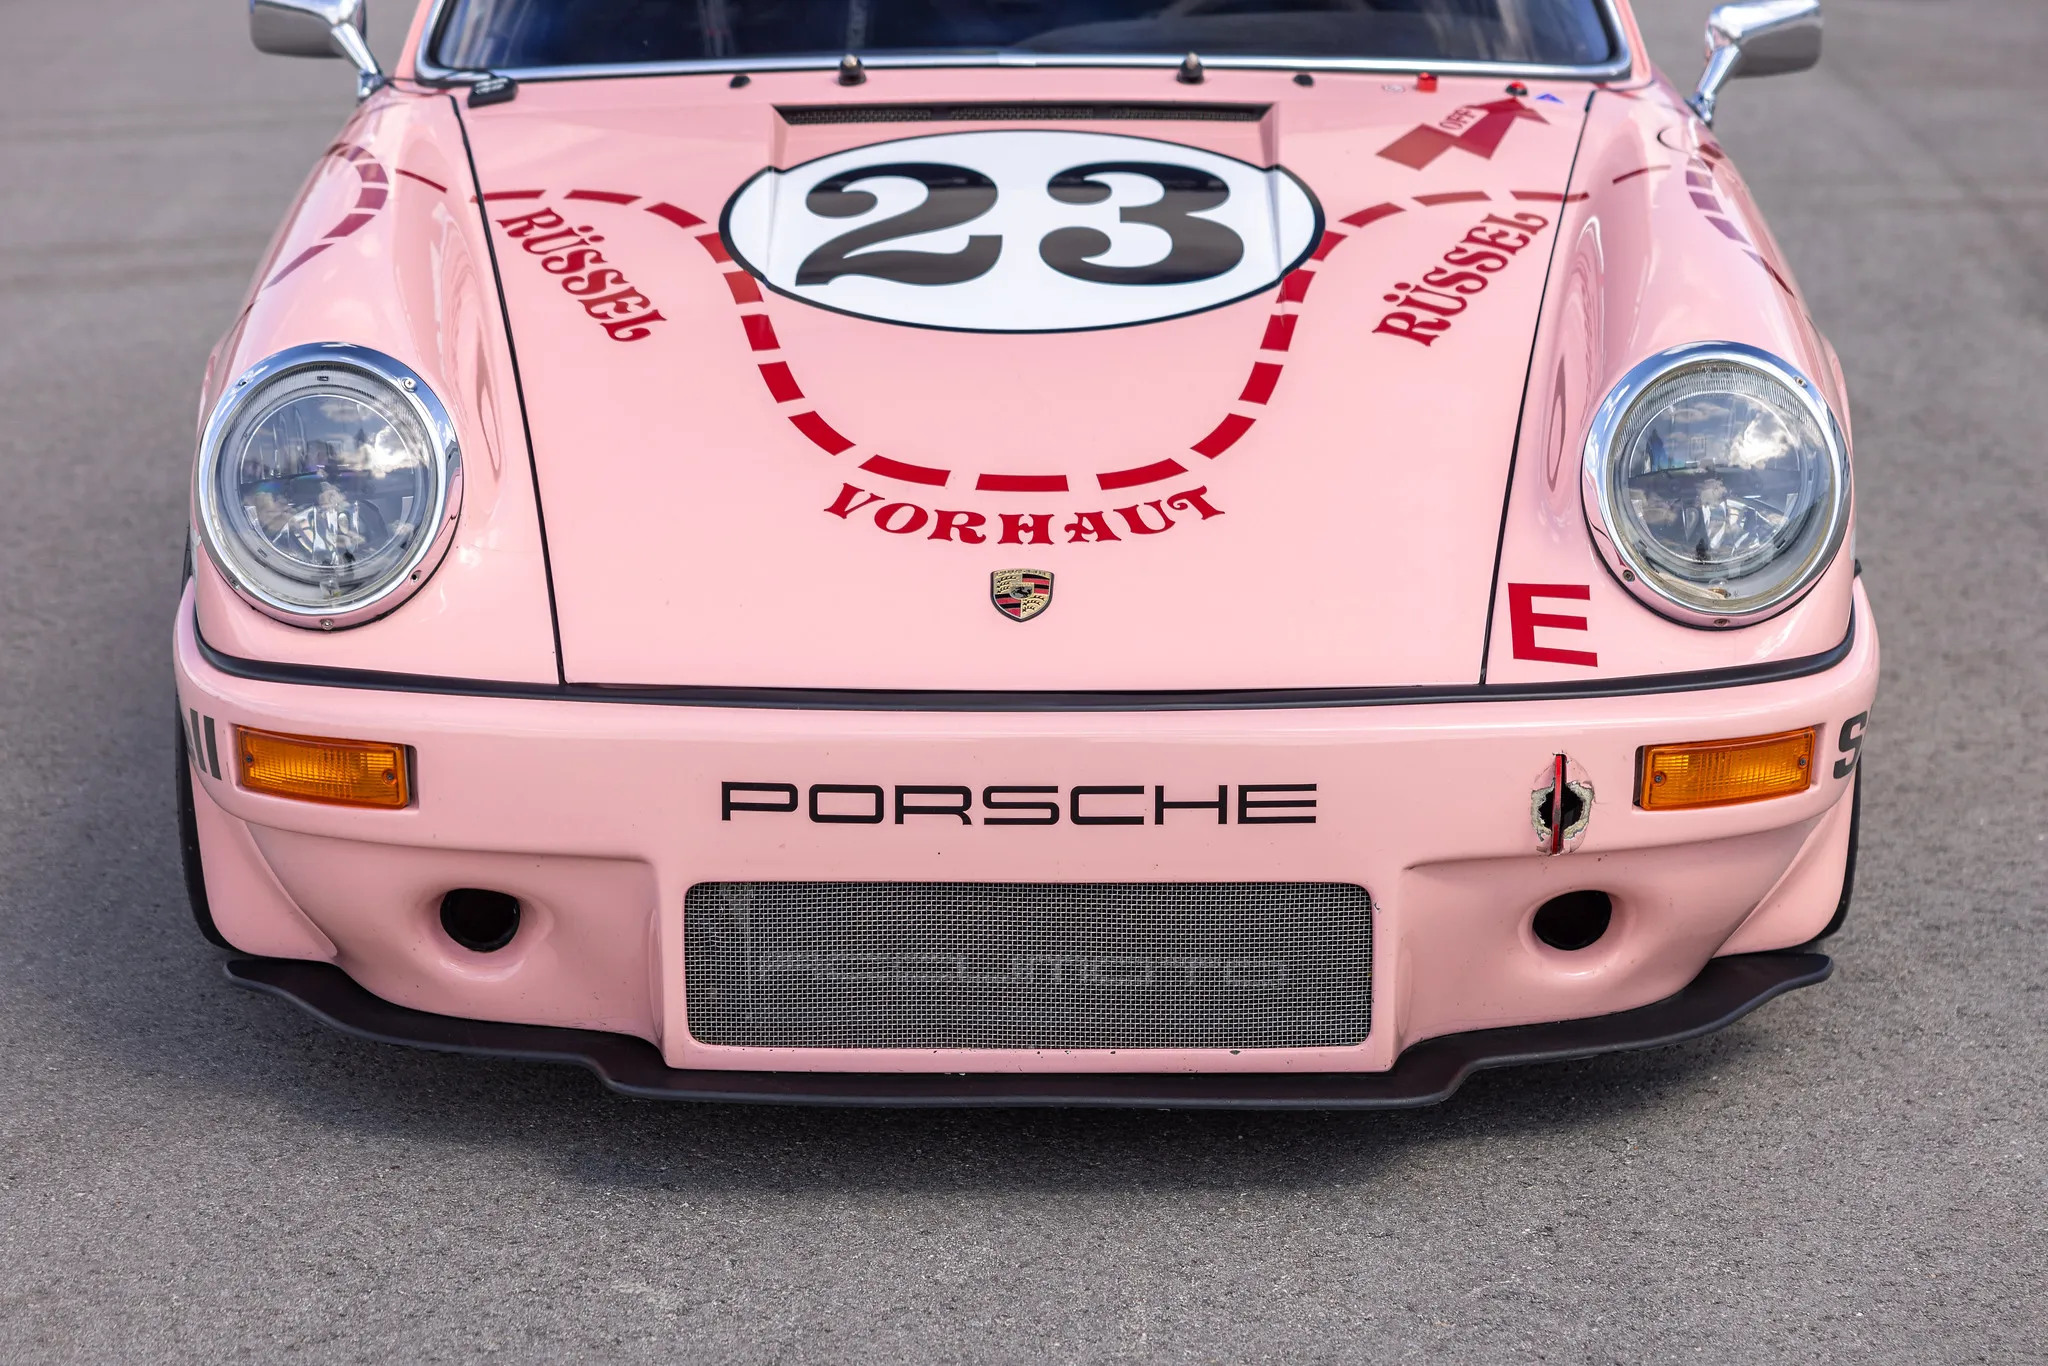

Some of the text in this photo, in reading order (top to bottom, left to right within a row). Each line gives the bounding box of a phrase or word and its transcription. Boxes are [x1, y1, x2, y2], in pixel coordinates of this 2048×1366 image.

[1439, 107, 1476, 131] OFF
[795, 160, 1245, 286] 23
[495, 207, 668, 342] RÜSSEL
[1371, 212, 1550, 347] RÜSSEL
[824, 482, 1226, 545] VORHAUT
[1508, 582, 1598, 667] E
[721, 781, 1318, 826] PORSCHE
